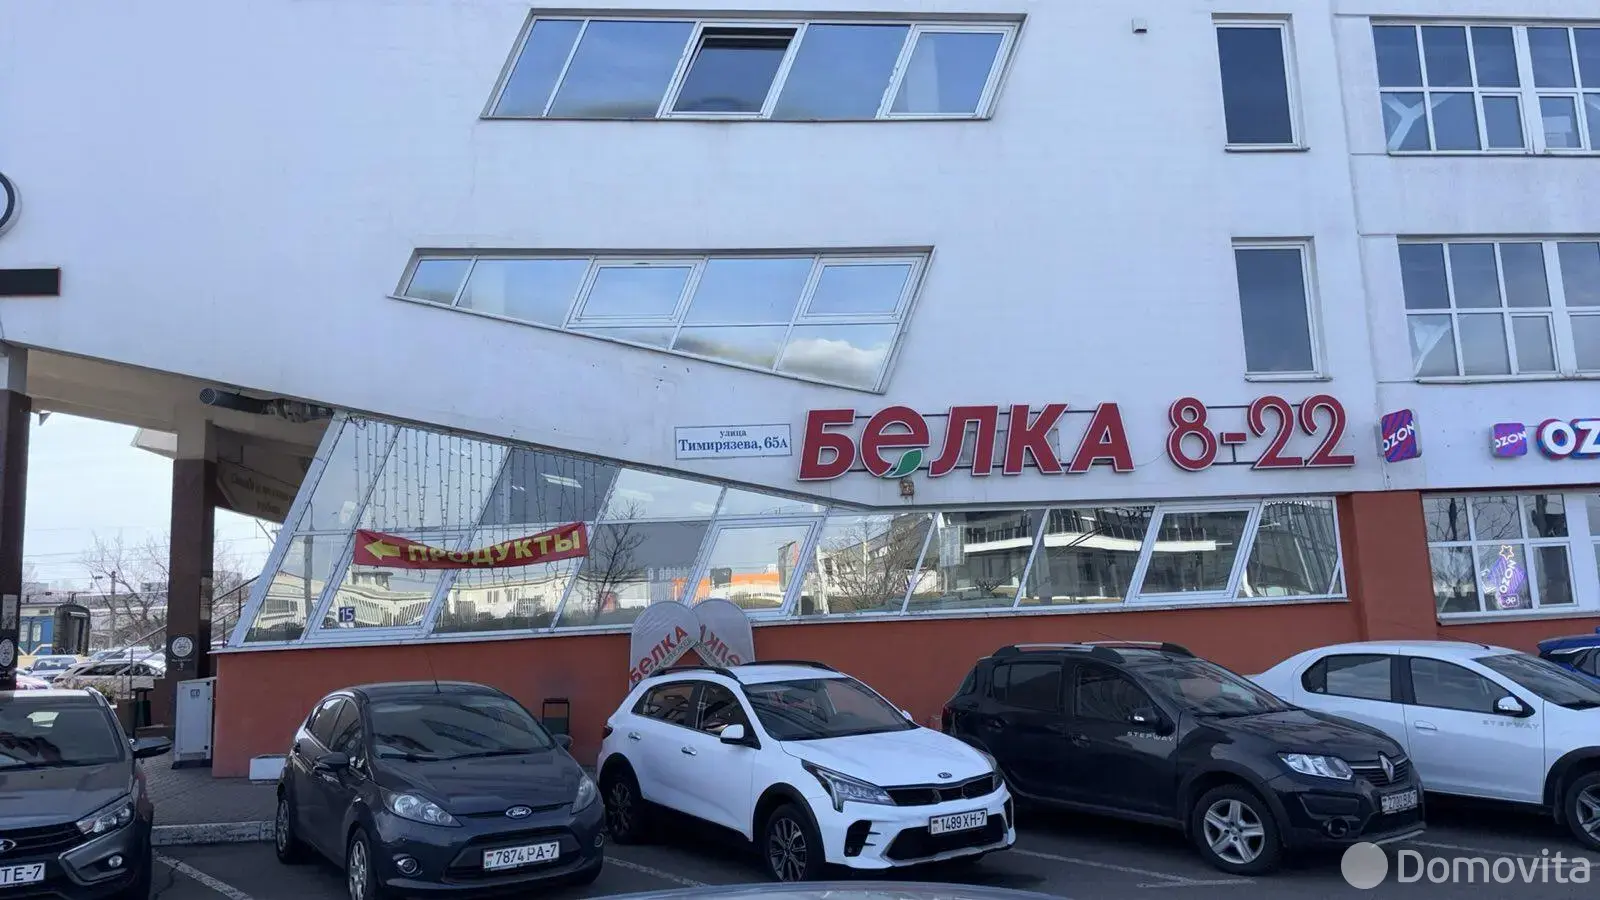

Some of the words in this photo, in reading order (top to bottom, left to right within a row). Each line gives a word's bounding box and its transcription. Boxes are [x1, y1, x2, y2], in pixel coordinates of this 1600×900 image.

[719, 429, 747, 438] улица
[1166, 394, 1356, 472] 8-22
[678, 438, 762, 452] Тимирязева,
[763, 436, 788, 449] 65А
[407, 531, 581, 566] ПРОДУКТЫ
[340, 608, 354, 621] 15
[1482, 719, 1541, 730] STEPWAY
[1126, 731, 1175, 742] STEPWAY
[940, 815, 962, 832] 1489
[495, 849, 524, 865] 7874
